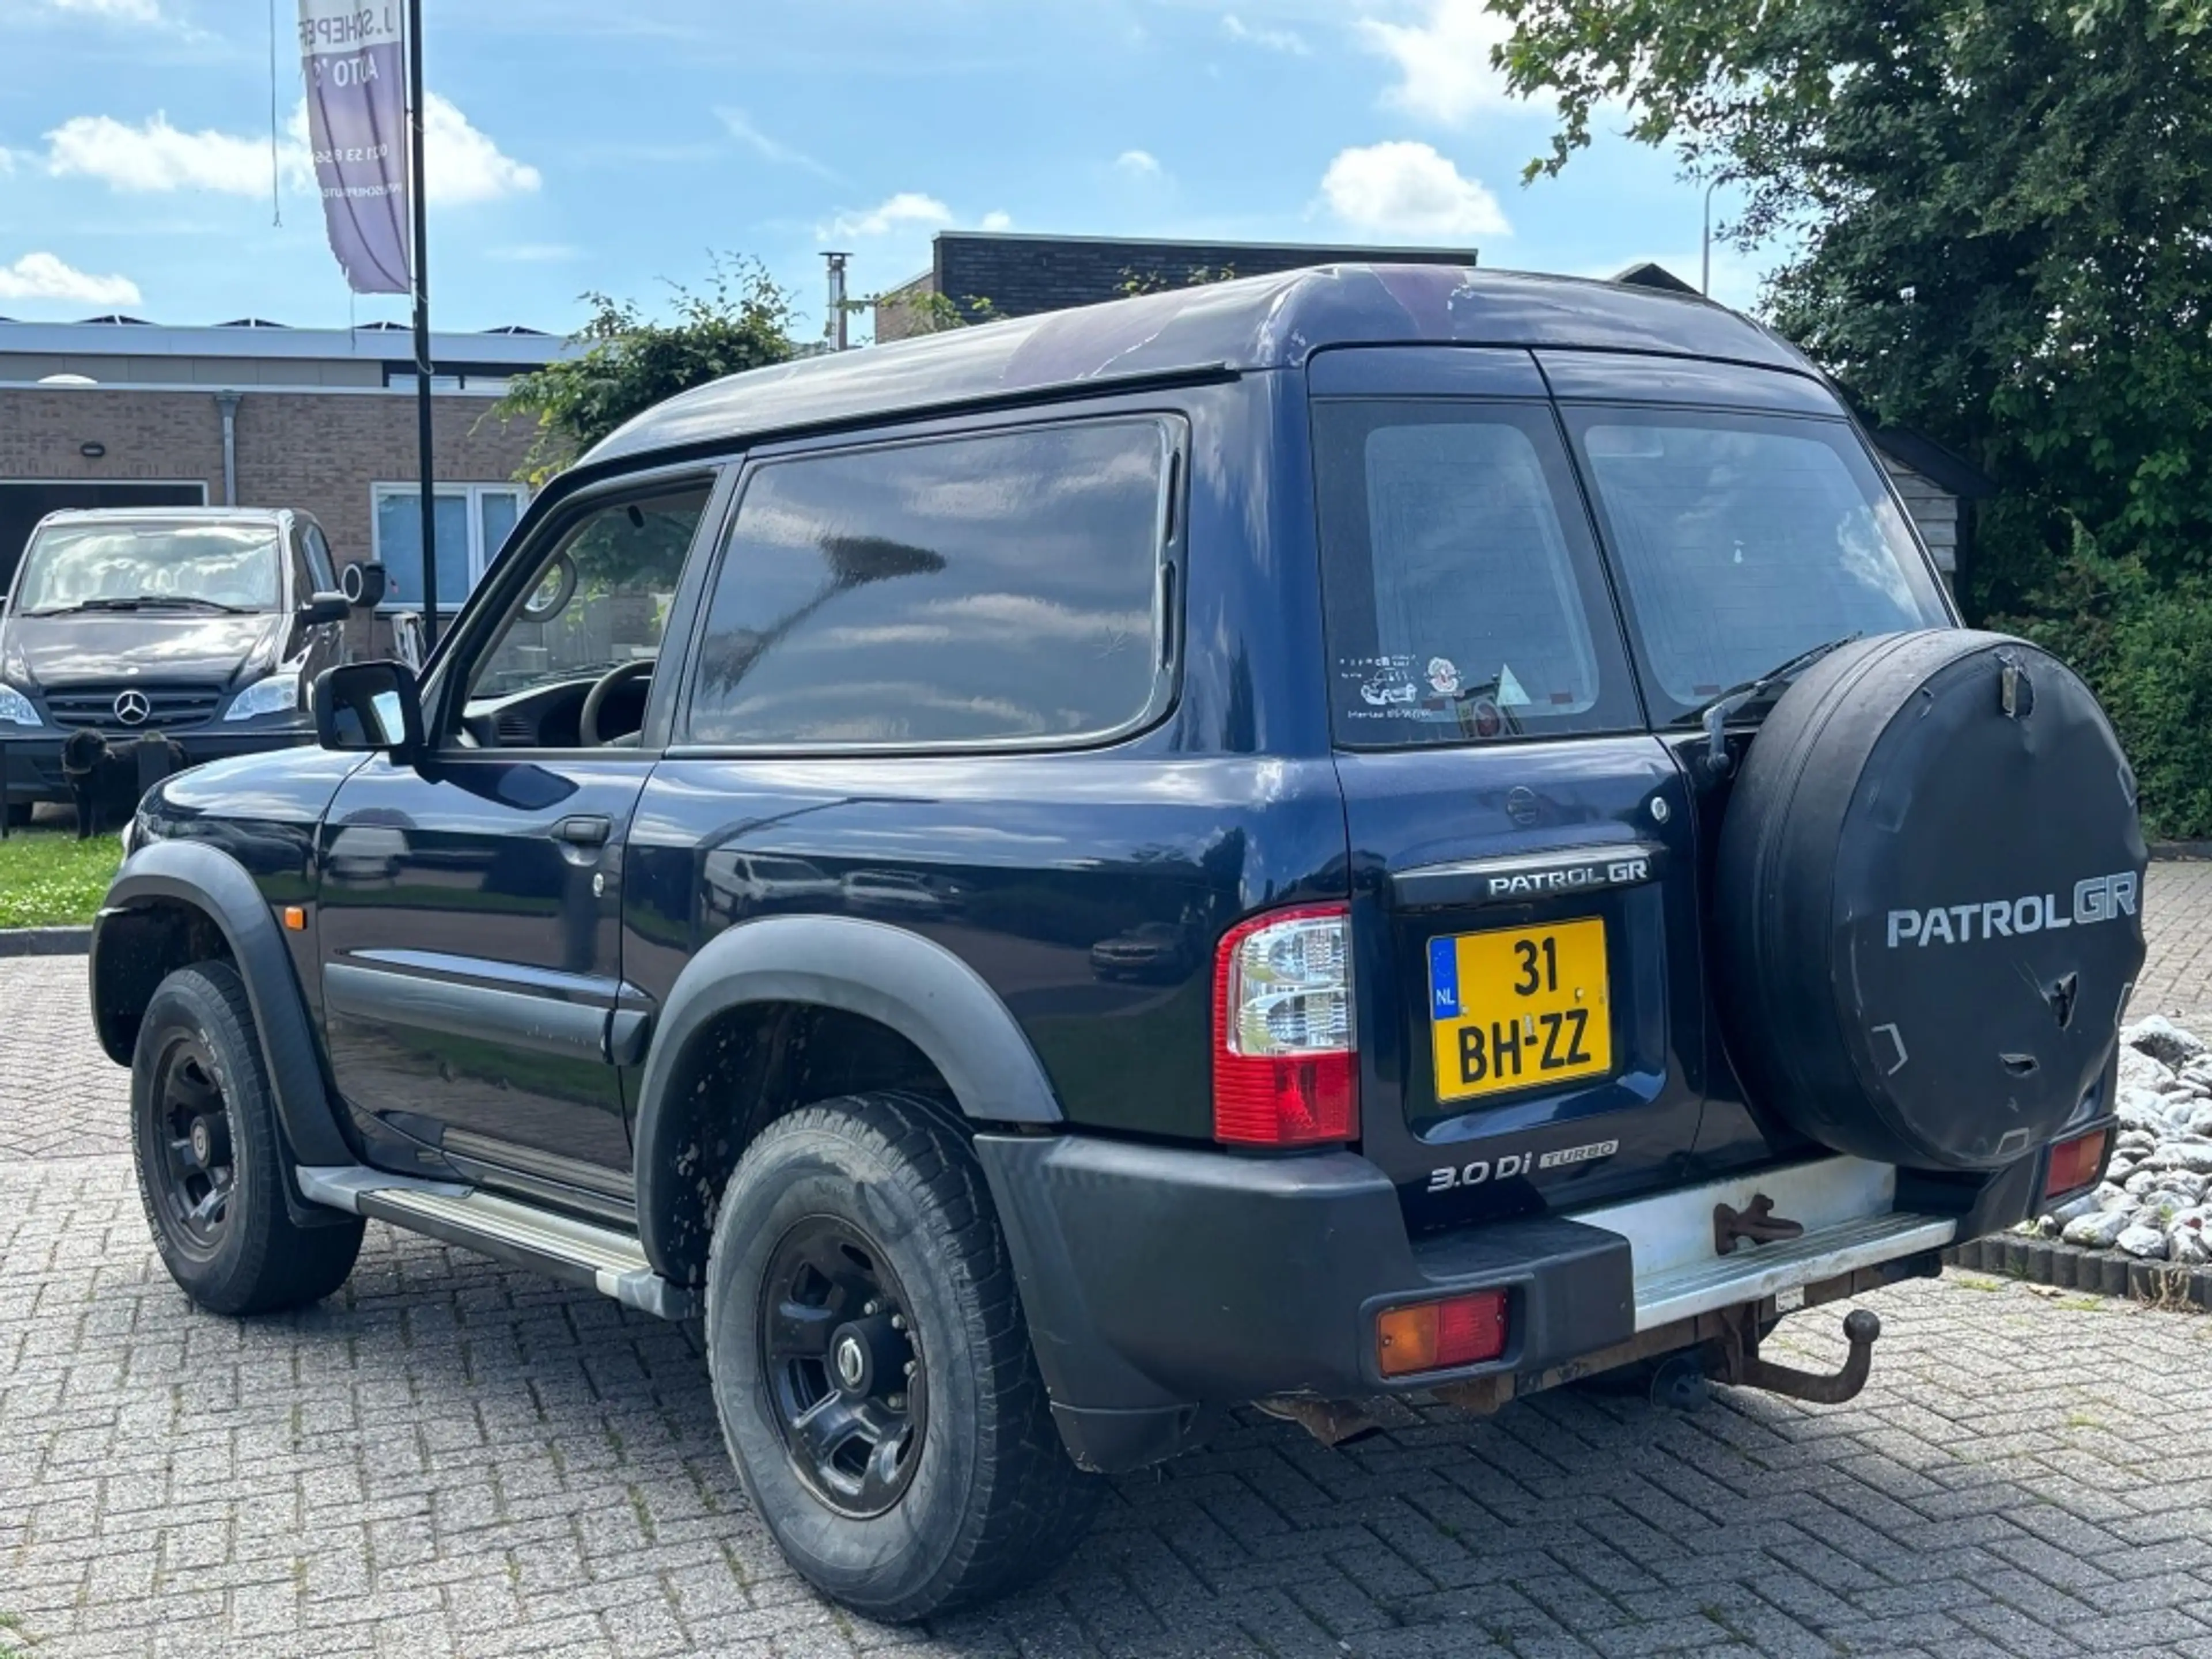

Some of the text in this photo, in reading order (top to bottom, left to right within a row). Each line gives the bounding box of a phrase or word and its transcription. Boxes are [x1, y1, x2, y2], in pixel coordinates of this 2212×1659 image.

[1488, 859, 1647, 896] PATROL GR
[1887, 870, 2138, 948] PATROL GR
[1514, 936, 1558, 996] 31
[1435, 987, 1456, 1005] NL
[1458, 1008, 1591, 1084] BH-ZZ
[1427, 1141, 1614, 1192] 3.0 Di TURBO
